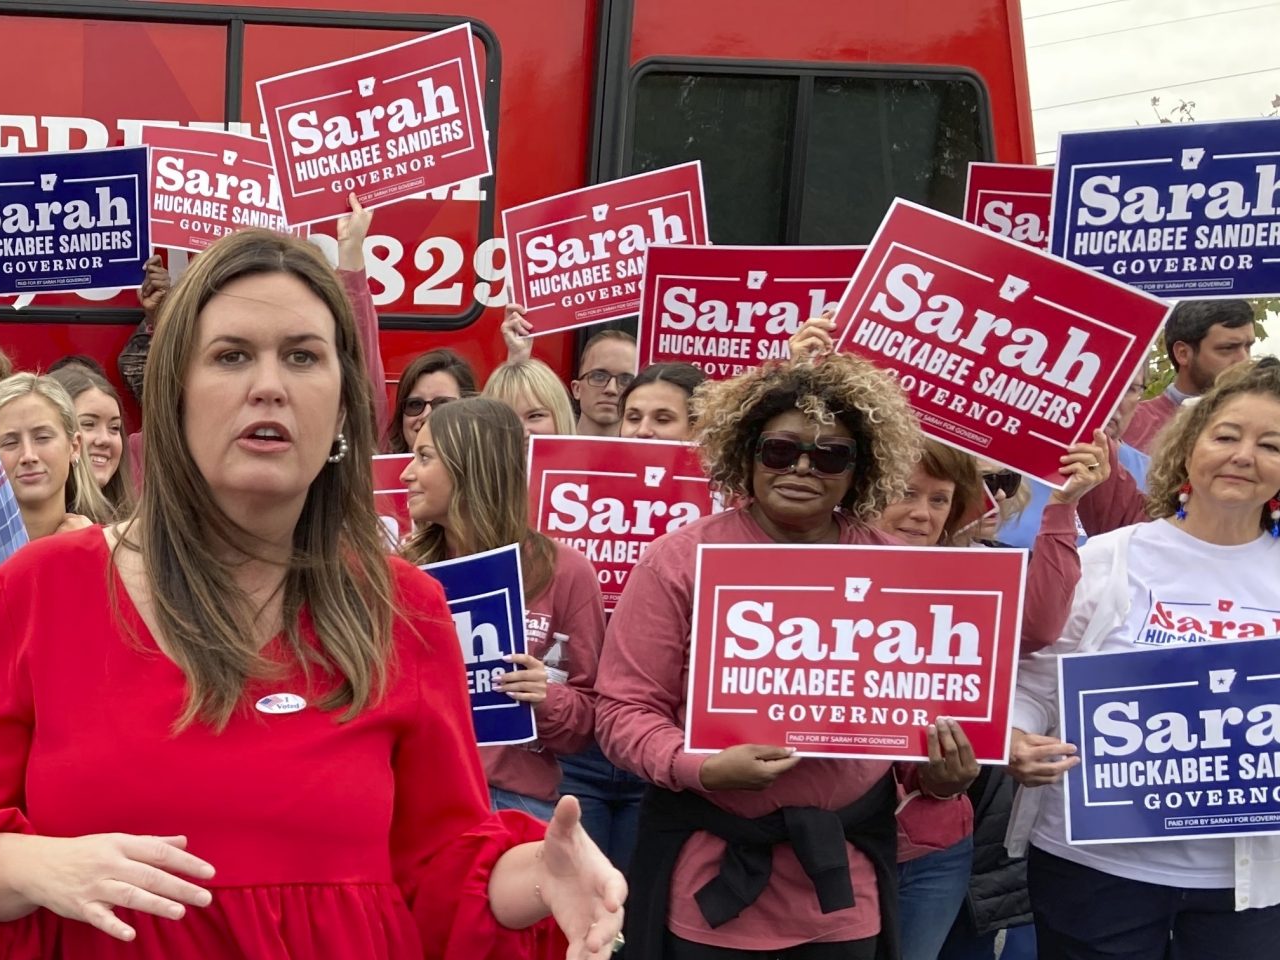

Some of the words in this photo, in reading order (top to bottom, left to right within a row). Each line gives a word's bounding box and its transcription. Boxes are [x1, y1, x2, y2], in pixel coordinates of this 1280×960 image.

[287, 76, 460, 158] Sarah
[295, 140, 382, 182] HUCKABEE
[386, 119, 464, 158] SANDERS
[331, 154, 435, 192] GOVERNOR
[154, 193, 228, 222] HUCKABEE
[59, 230, 132, 253] SANDERS
[180, 219, 240, 237] GOVER
[525, 206, 687, 276] Sarah
[1074, 228, 1187, 256] HUCKABEE
[3, 257, 103, 274] GOVERNOR
[1113, 254, 1253, 275] GOVERNOR
[529, 263, 612, 298] HUCKABEE
[869, 263, 1102, 397] Sarah
[658, 333, 751, 360] HUCKABEE
[852, 318, 975, 387] HUCKABEE
[973, 367, 1082, 429] SANDERS
[942, 420, 955, 431] FOR
[955, 426, 988, 444] GOVERNOR
[724, 600, 982, 666] Sarah
[721, 667, 855, 697] HUCKABEE
[863, 670, 981, 702] SANDERS
[768, 704, 929, 727] GOVERNOR
[820, 735, 829, 743] BY
[830, 736, 853, 744] SARAH
[869, 737, 906, 746] GOVERNOR
[1095, 755, 1230, 788] HUCKABEE
[1209, 817, 1233, 825] SARAH
